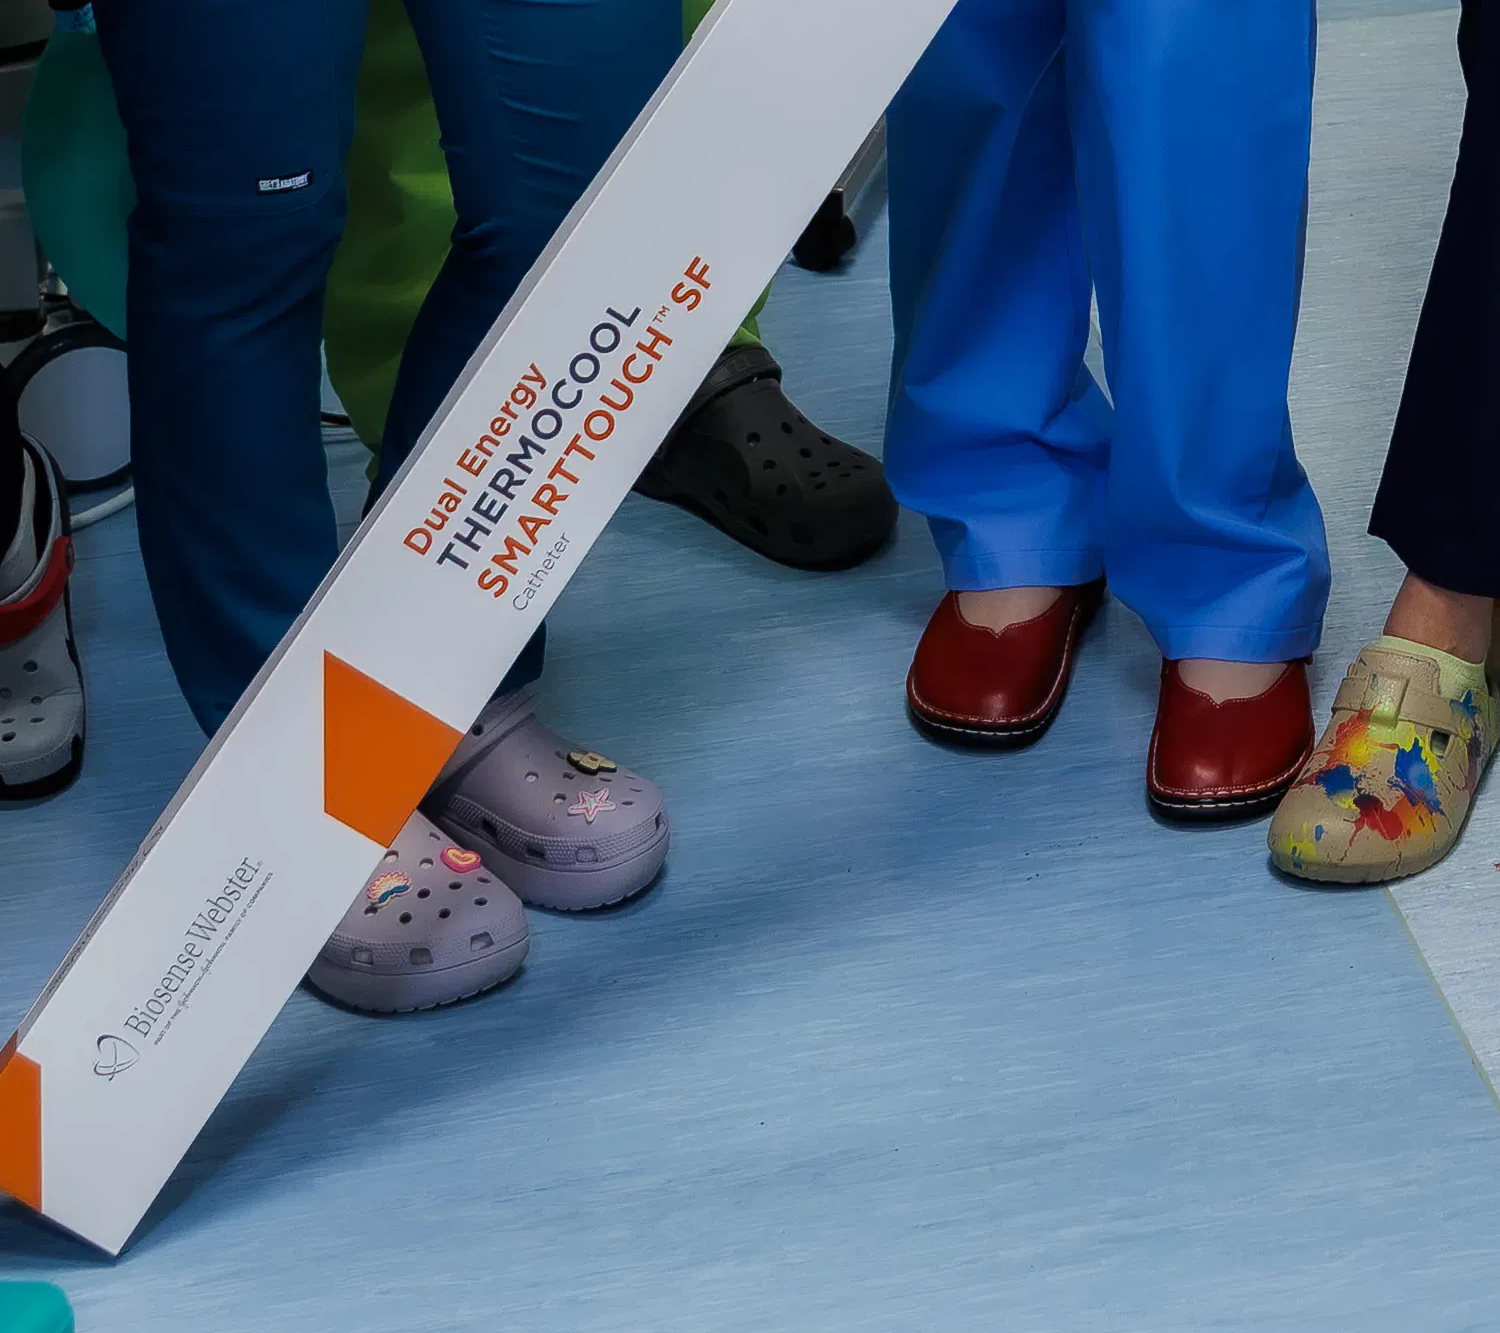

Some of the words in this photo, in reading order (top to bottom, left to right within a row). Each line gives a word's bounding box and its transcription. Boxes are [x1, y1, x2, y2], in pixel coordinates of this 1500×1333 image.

[670, 255, 712, 312] SF
[403, 477, 468, 556] Dual
[456, 362, 548, 478] Energy
[435, 306, 642, 571] THERMOCOOL
[512, 532, 571, 612] Catheter
[123, 942, 203, 1038] Biosense
[185, 856, 260, 943] Webster
[246, 871, 274, 909] COMPANIES
